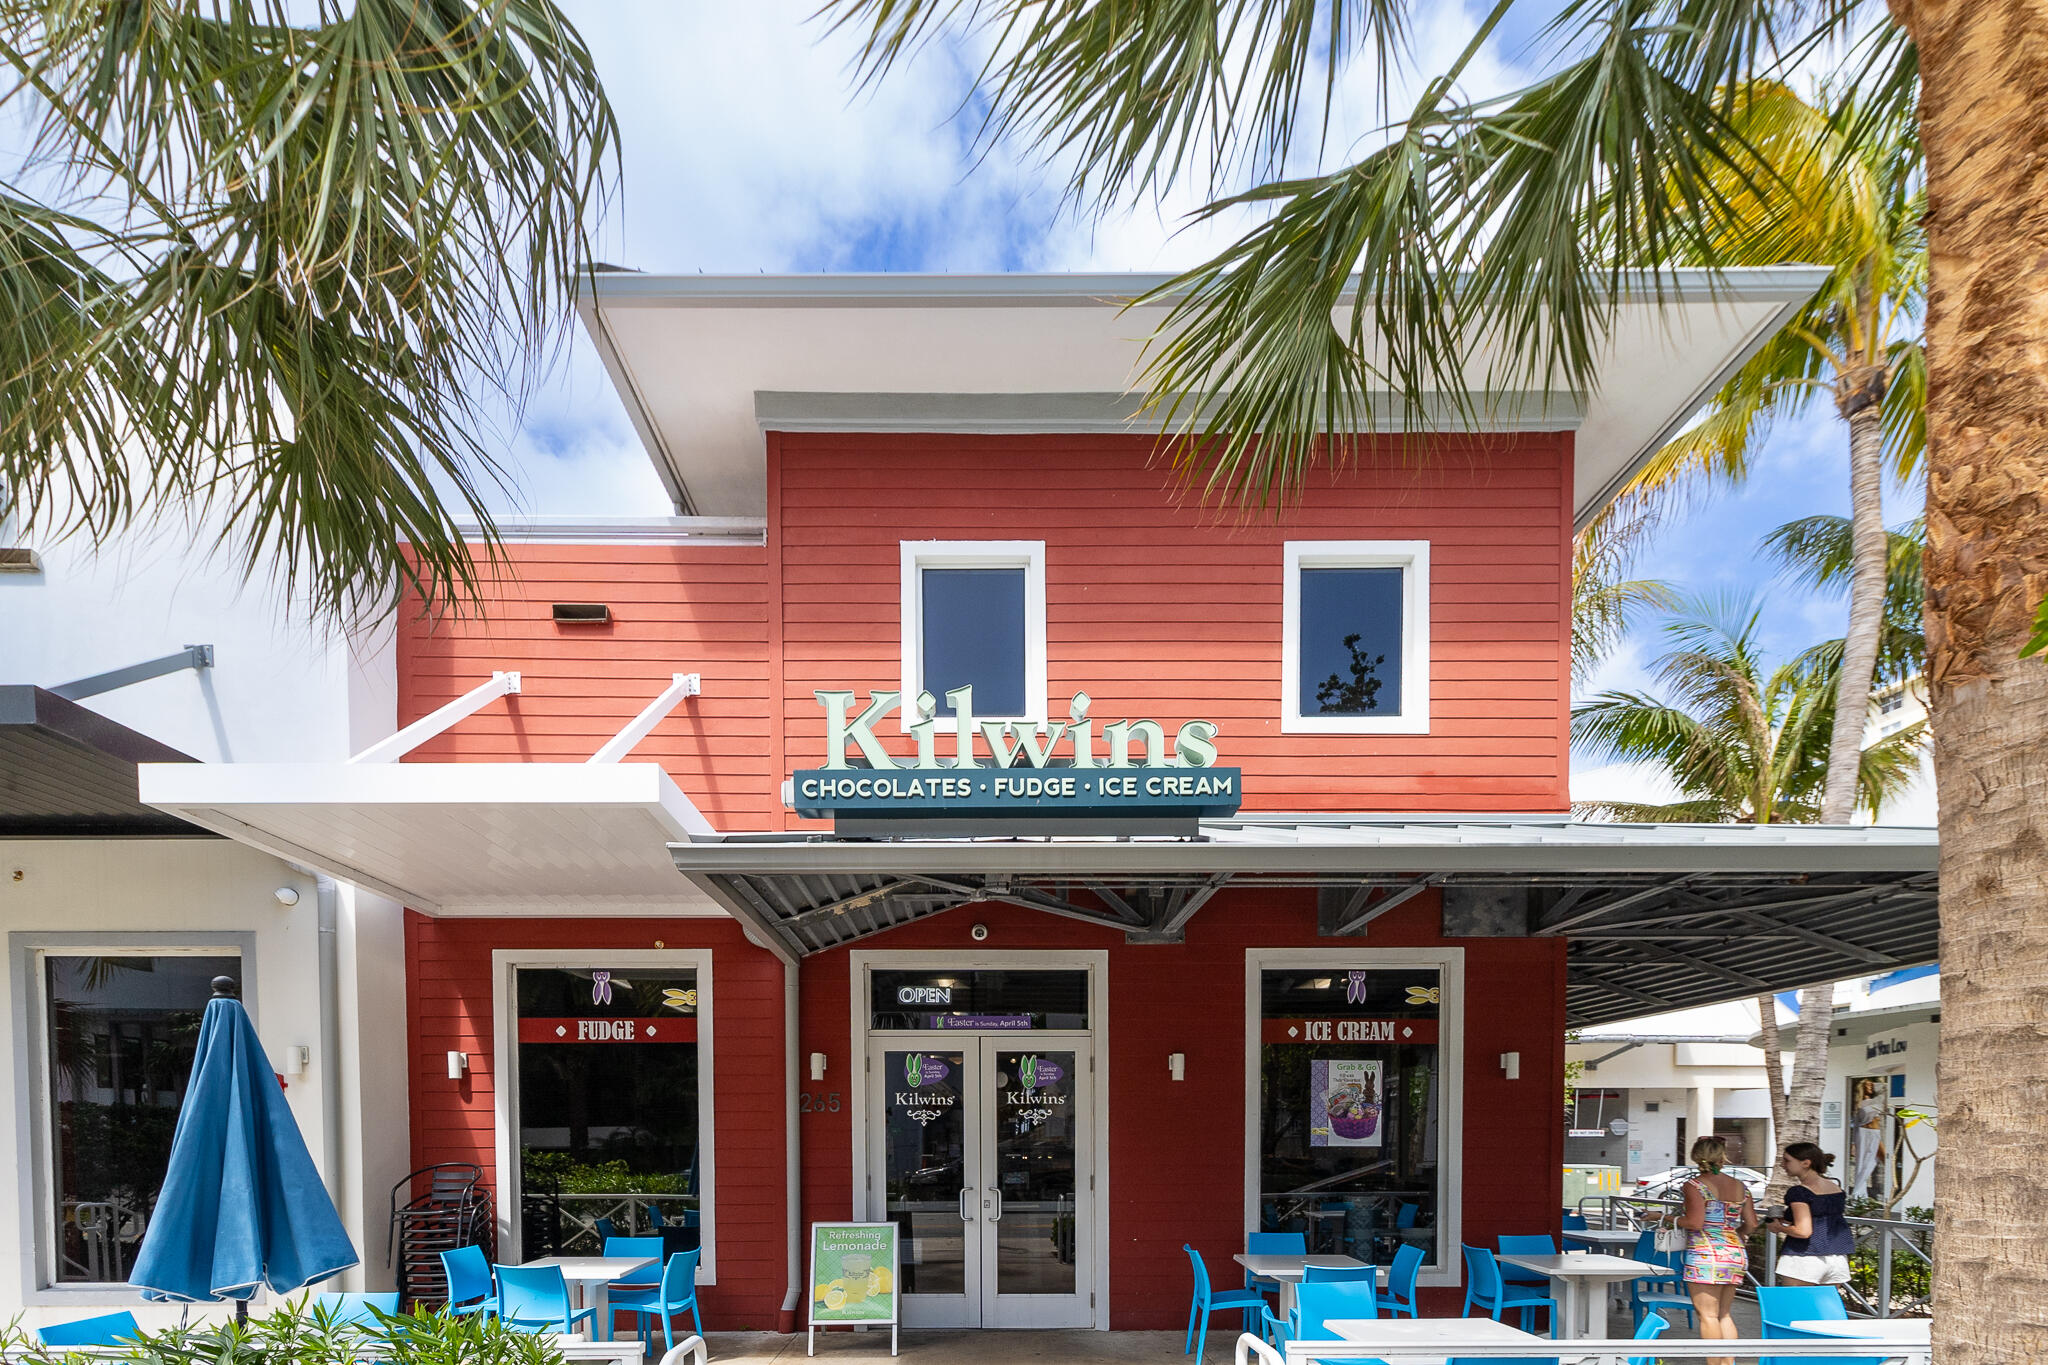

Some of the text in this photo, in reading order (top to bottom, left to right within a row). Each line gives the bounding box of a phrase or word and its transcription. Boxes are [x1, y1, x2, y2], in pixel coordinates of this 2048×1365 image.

[814, 684, 1218, 769] Kilwins
[801, 776, 1233, 798] CHOCOLATES FUDGE ICE CREAM
[898, 987, 951, 1004] OPEN
[947, 1017, 975, 1027] Easter
[1000, 1019, 1016, 1028] April
[1017, 1019, 1029, 1027] 5th
[577, 1020, 635, 1040] FUDGE
[1304, 1021, 1395, 1041] ICE CREAM
[922, 1063, 943, 1071] Easter
[1336, 1063, 1377, 1071] Grab & Go
[800, 1093, 841, 1112] 265
[895, 1092, 954, 1106] Kilwins
[1006, 1091, 1065, 1105] Kilwins
[829, 1230, 881, 1241] Refreshing
[823, 1240, 887, 1251] Lemonade
